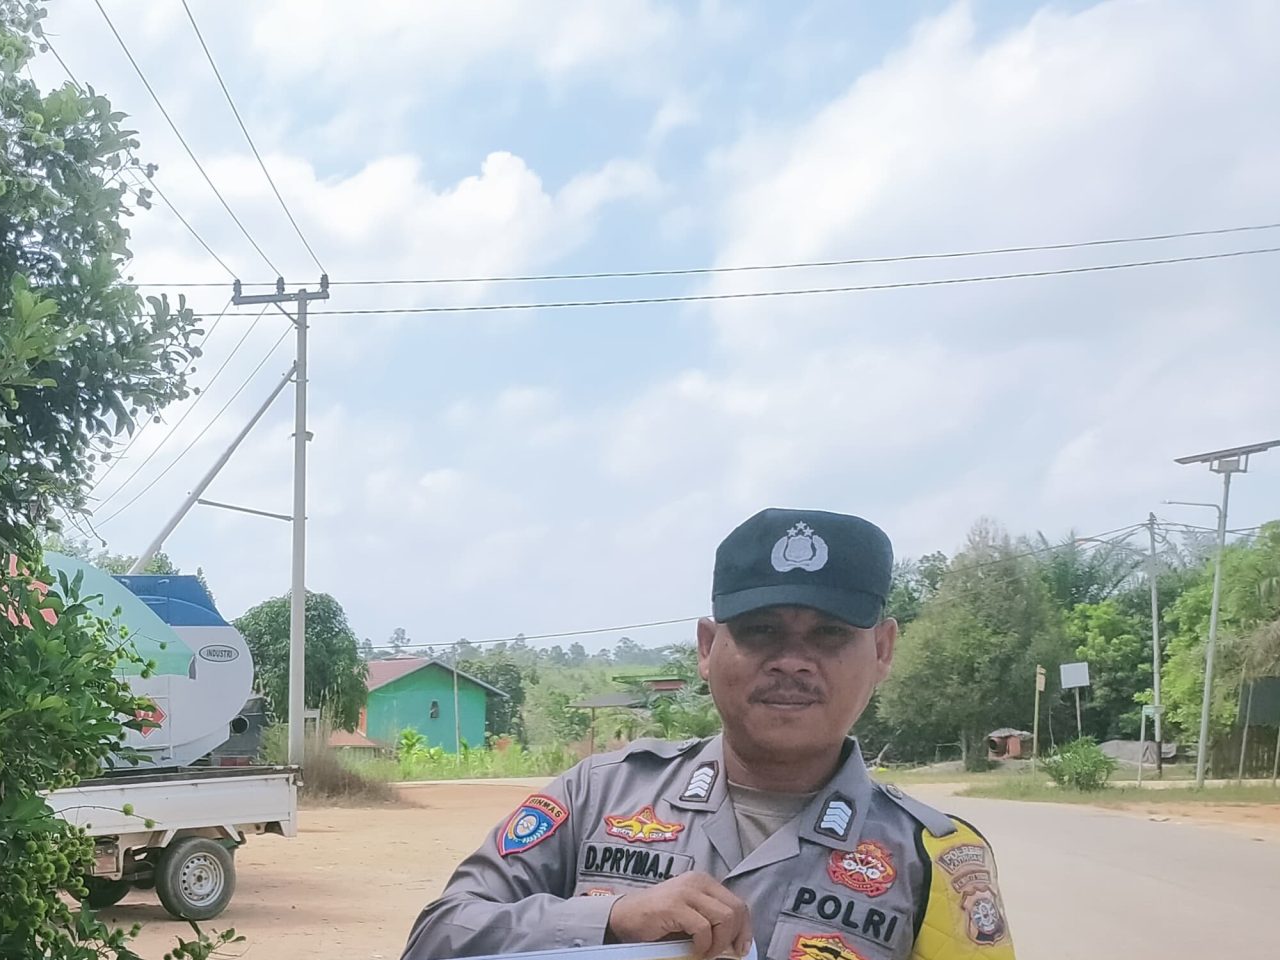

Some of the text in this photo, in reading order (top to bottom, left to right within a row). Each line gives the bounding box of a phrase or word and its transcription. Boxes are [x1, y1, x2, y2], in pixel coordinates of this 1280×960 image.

[206, 649, 232, 659] INDUSTRI
[530, 797, 563, 818] BINMAS
[792, 886, 899, 943] POLRI
